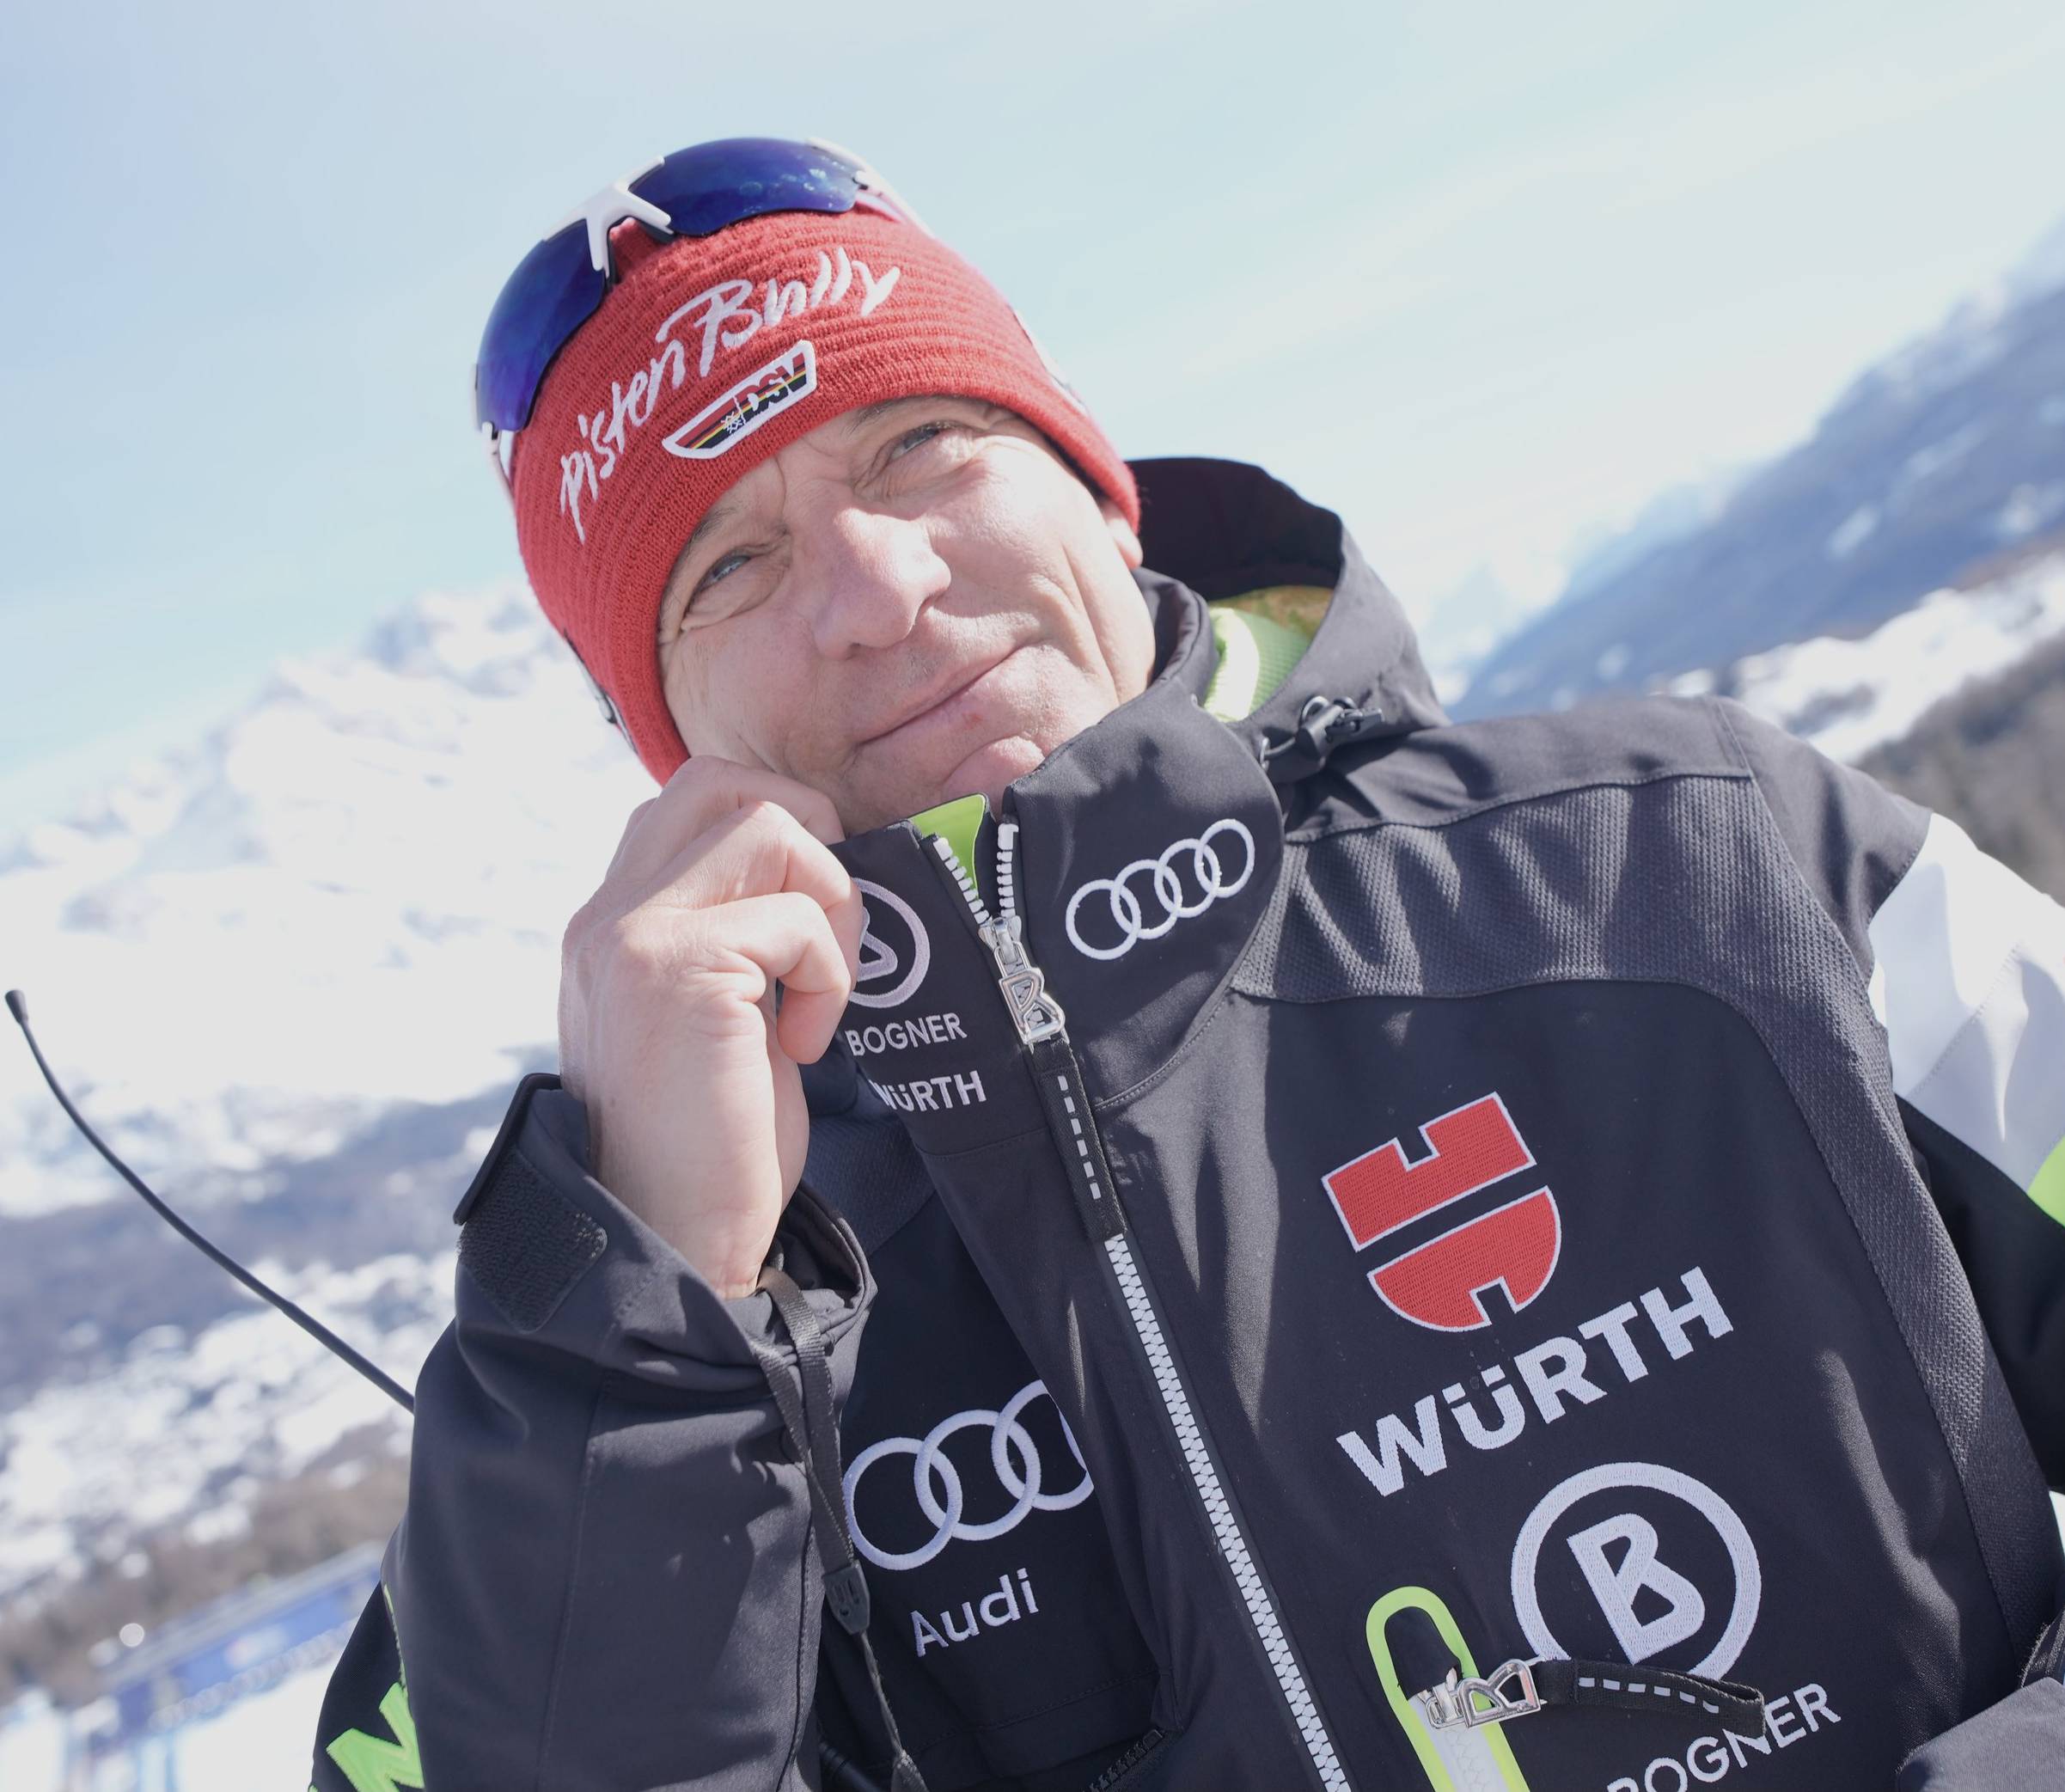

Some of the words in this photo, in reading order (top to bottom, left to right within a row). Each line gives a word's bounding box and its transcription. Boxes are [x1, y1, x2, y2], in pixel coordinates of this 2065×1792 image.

[735, 352, 808, 425] DSV
[845, 1012, 968, 1056] BOGNER
[1336, 1266, 1734, 1497] WÜRTH
[910, 1567, 1040, 1657] Audi
[1566, 1513, 1706, 1665] B
